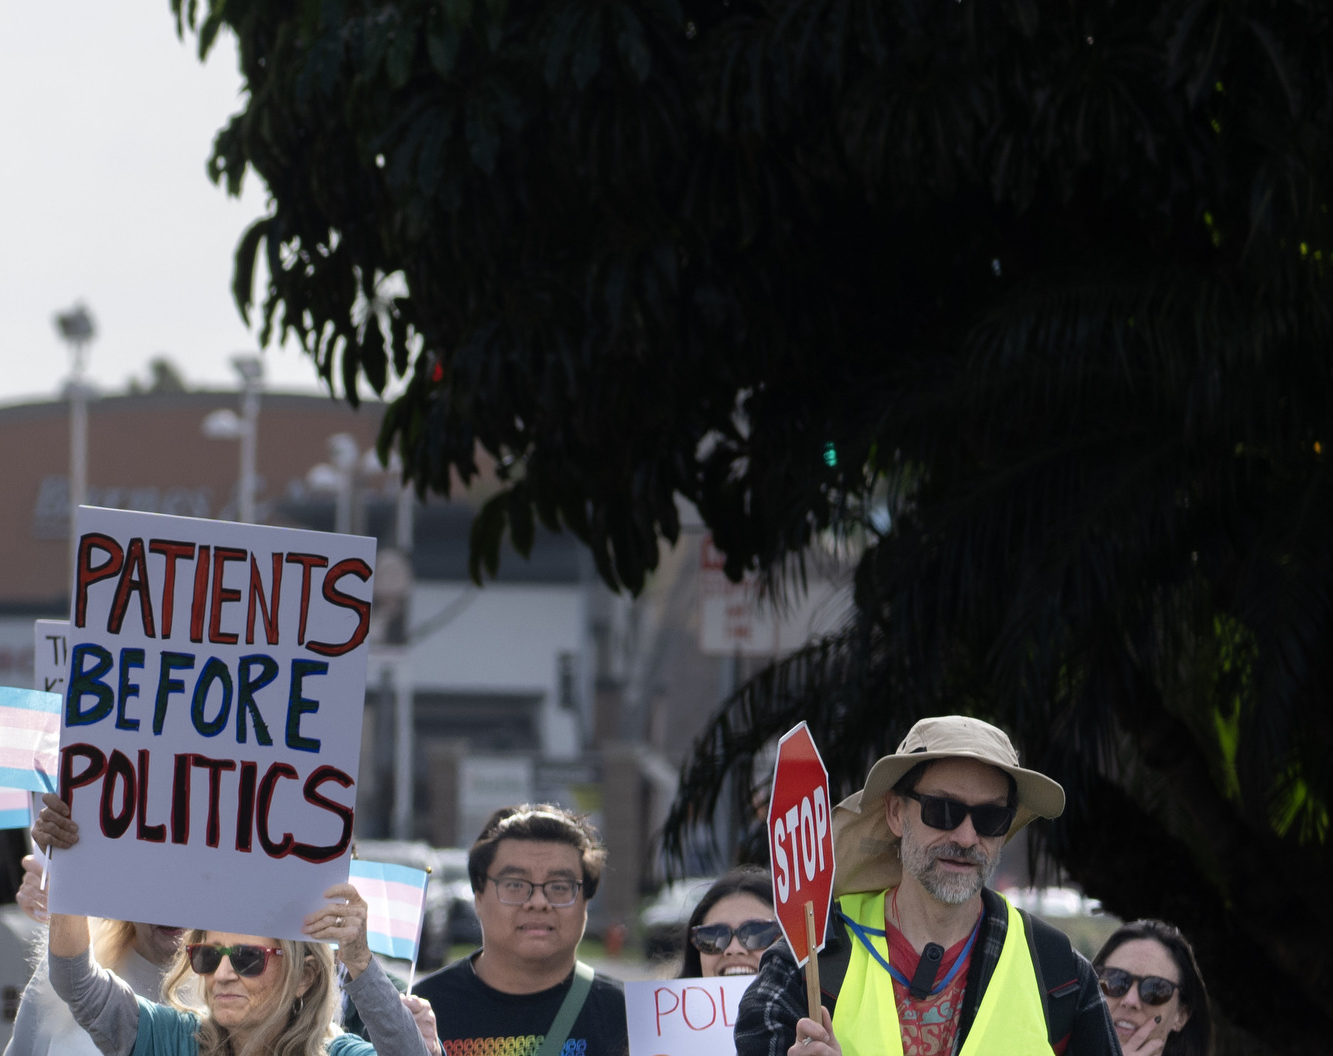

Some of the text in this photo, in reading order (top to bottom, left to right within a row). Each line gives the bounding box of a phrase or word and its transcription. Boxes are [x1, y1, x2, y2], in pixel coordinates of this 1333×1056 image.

[75, 532, 373, 657] PATIENTS
[65, 643, 329, 753] BEFORE
[60, 743, 355, 864] POLITICS
[774, 785, 827, 904] STOP
